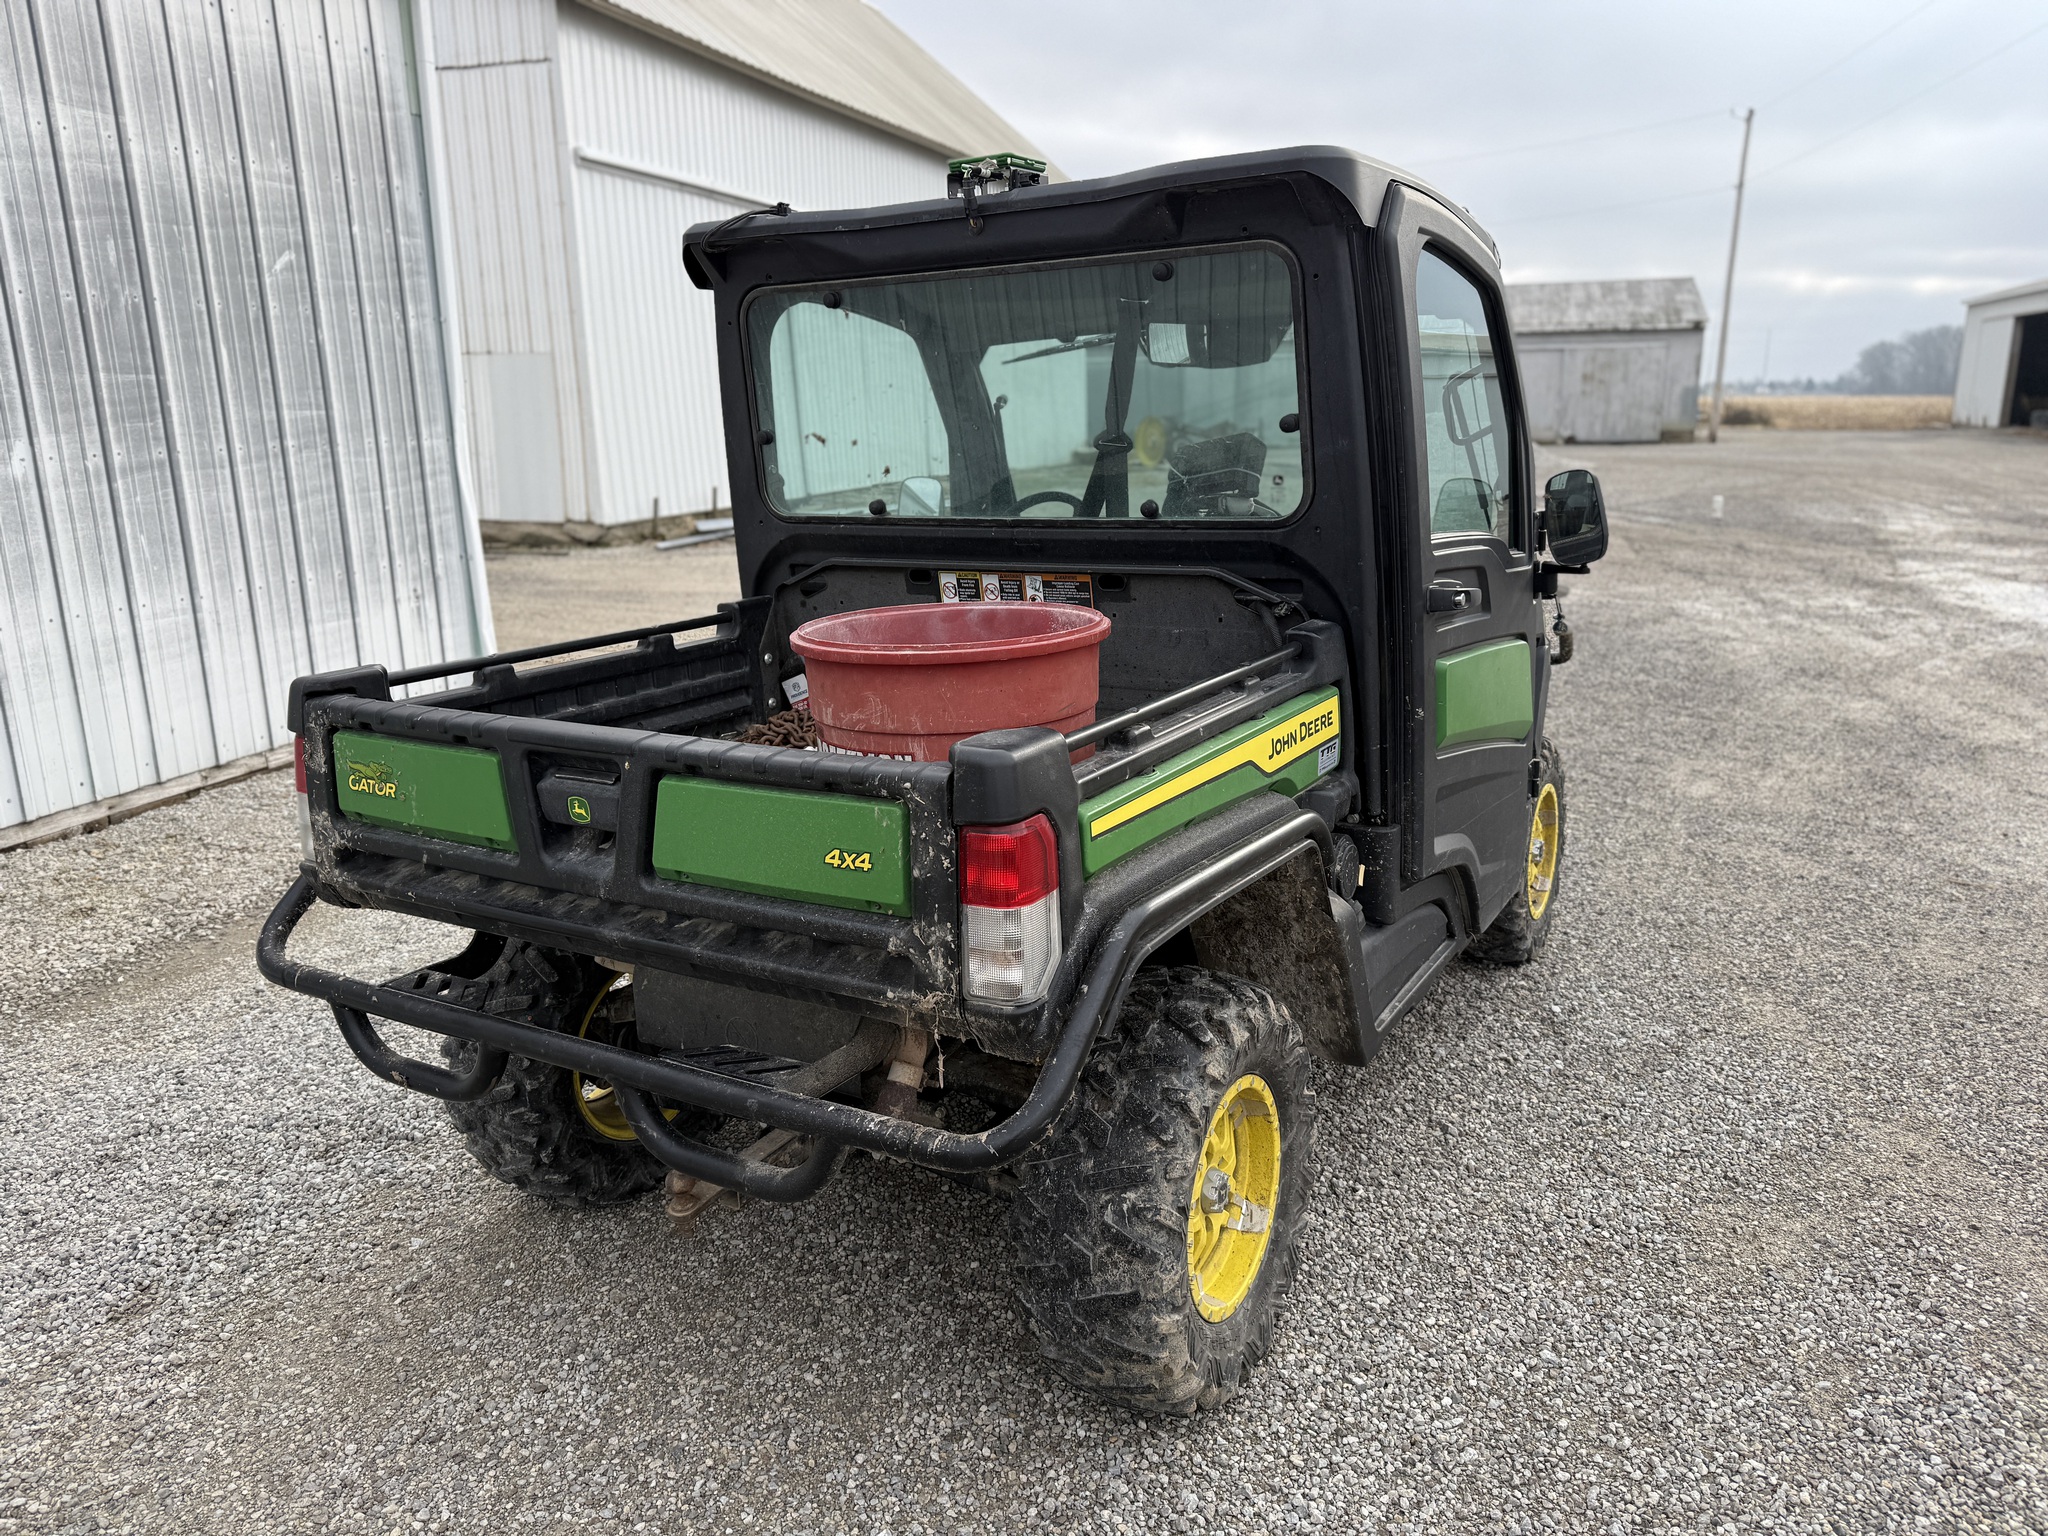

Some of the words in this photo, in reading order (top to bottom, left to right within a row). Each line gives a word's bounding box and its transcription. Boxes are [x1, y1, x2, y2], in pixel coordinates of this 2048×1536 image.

[1269, 729, 1297, 760] JOHN
[1300, 710, 1333, 742] DEERE
[348, 774, 396, 799] GATOR
